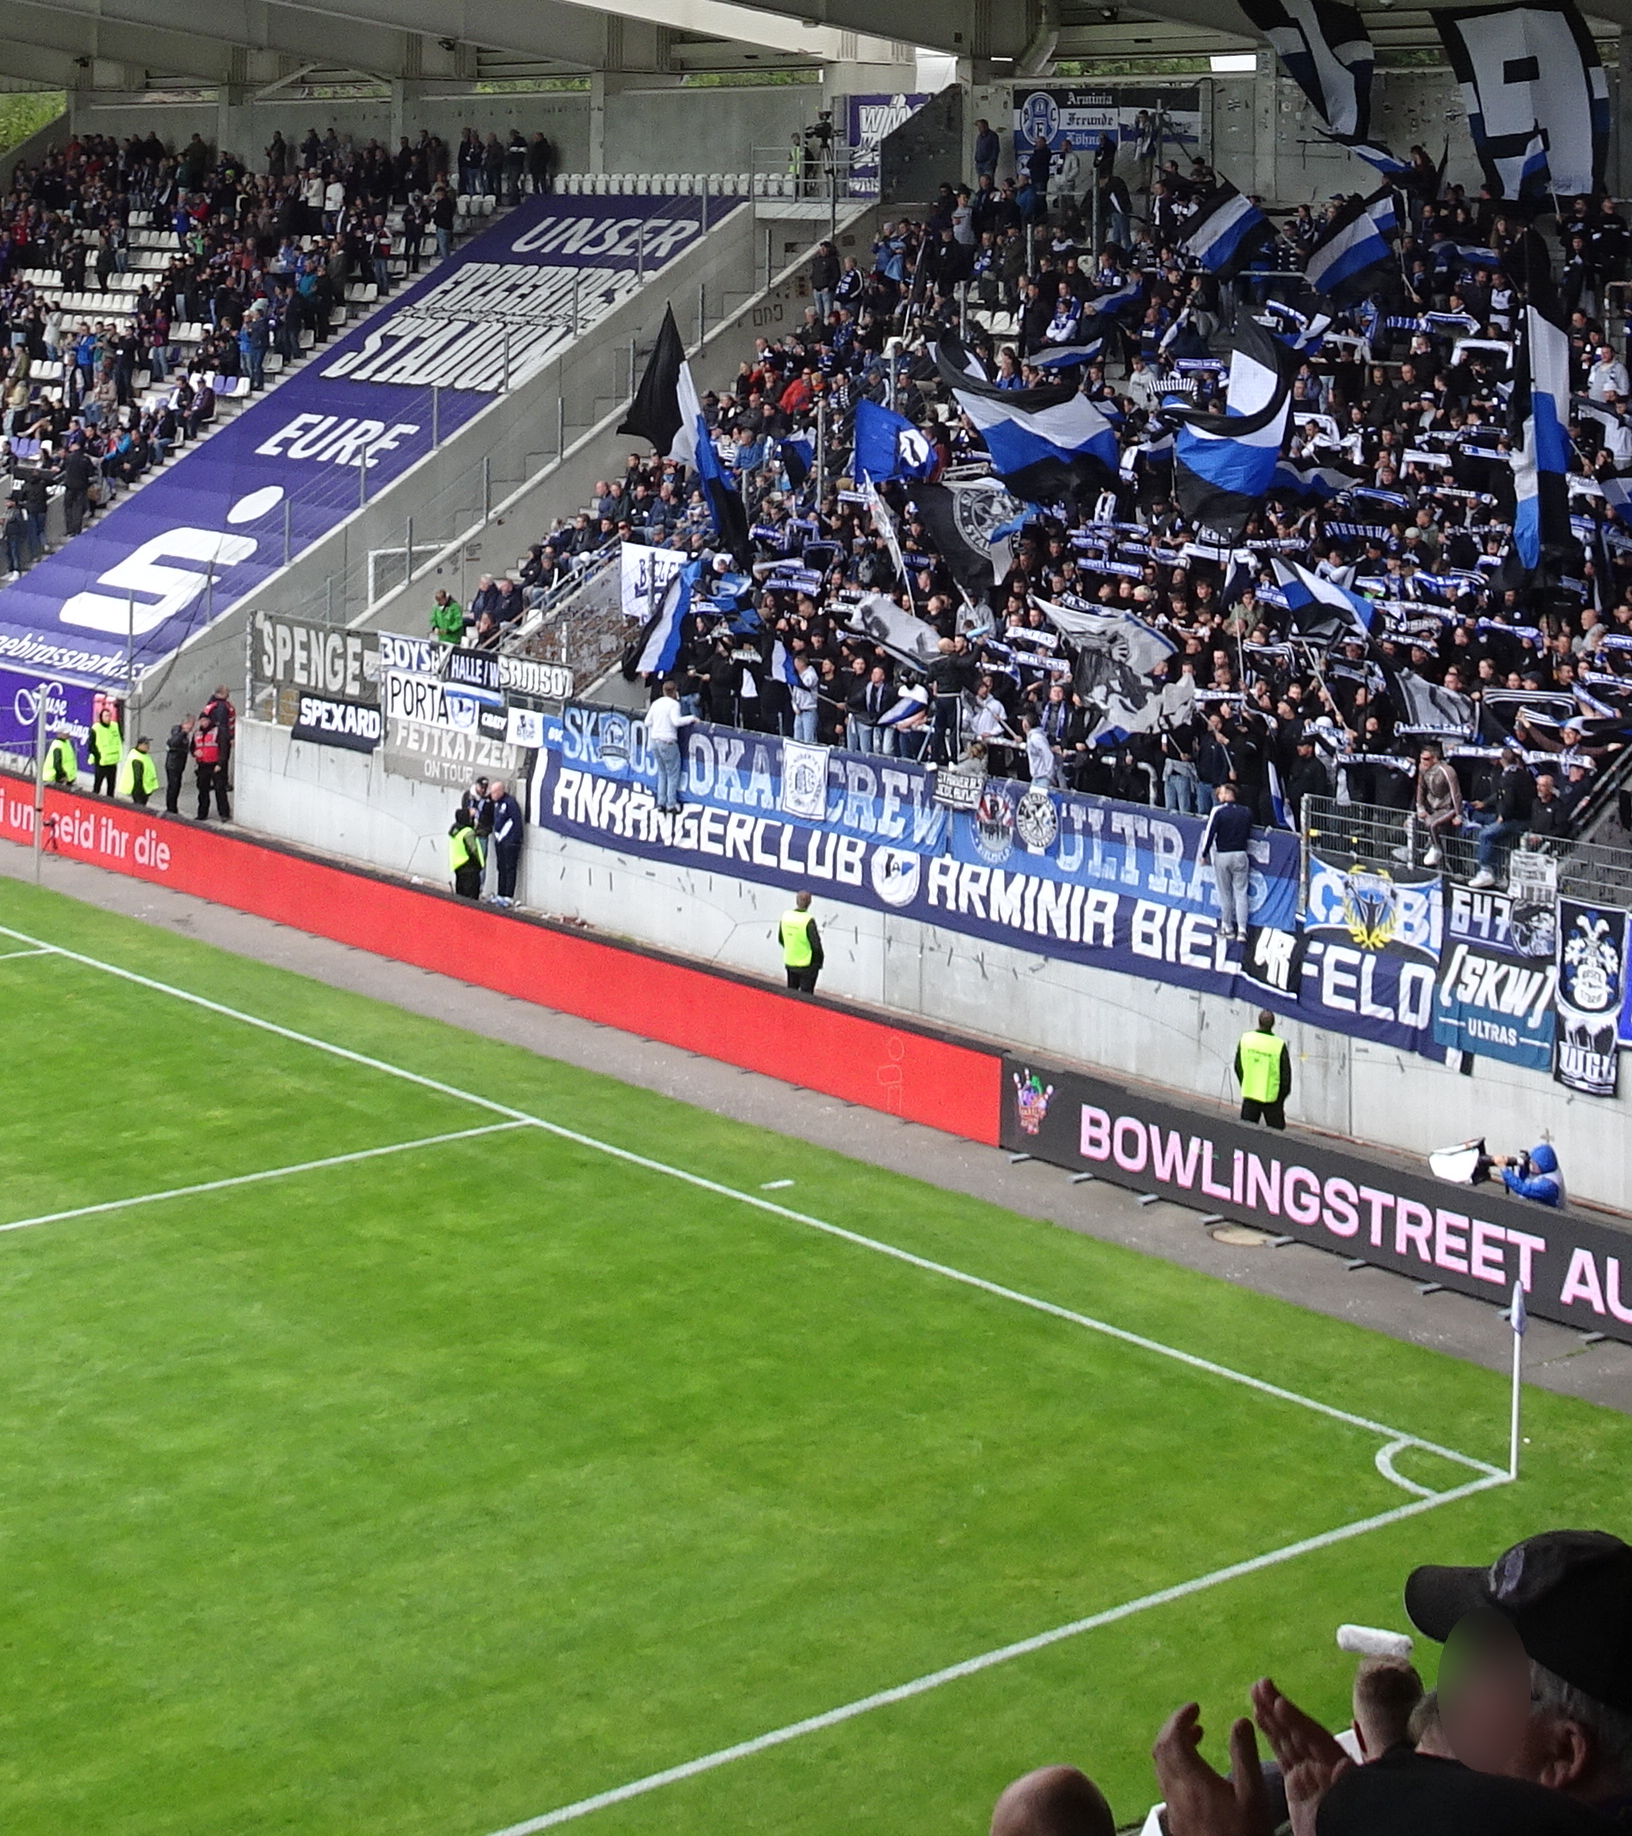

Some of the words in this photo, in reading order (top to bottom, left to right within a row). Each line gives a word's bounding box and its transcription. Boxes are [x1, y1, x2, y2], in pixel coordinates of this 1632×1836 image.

[512, 217, 699, 257] UNSER
[255, 413, 420, 468] EURE
[261, 619, 362, 696] SPENGE
[300, 696, 381, 739] SPEXARD
[390, 675, 449, 725] PORTA
[396, 719, 516, 770] FETTKATZEN
[424, 759, 440, 778] ON
[442, 762, 474, 783] TOUR
[678, 733, 784, 811] OKA
[10, 800, 38, 831] un
[100, 815, 130, 858] ihr
[134, 828, 170, 871] die
[552, 767, 867, 886] ANHÄNGERCLUB
[928, 853, 1119, 949] ARMINIA
[1131, 897, 1437, 1031] BIELFELD
[1450, 889, 1512, 942] 647
[1468, 1017, 1518, 1047] ULTRAS
[1079, 1104, 1546, 1291] BOWLINGSTREET
